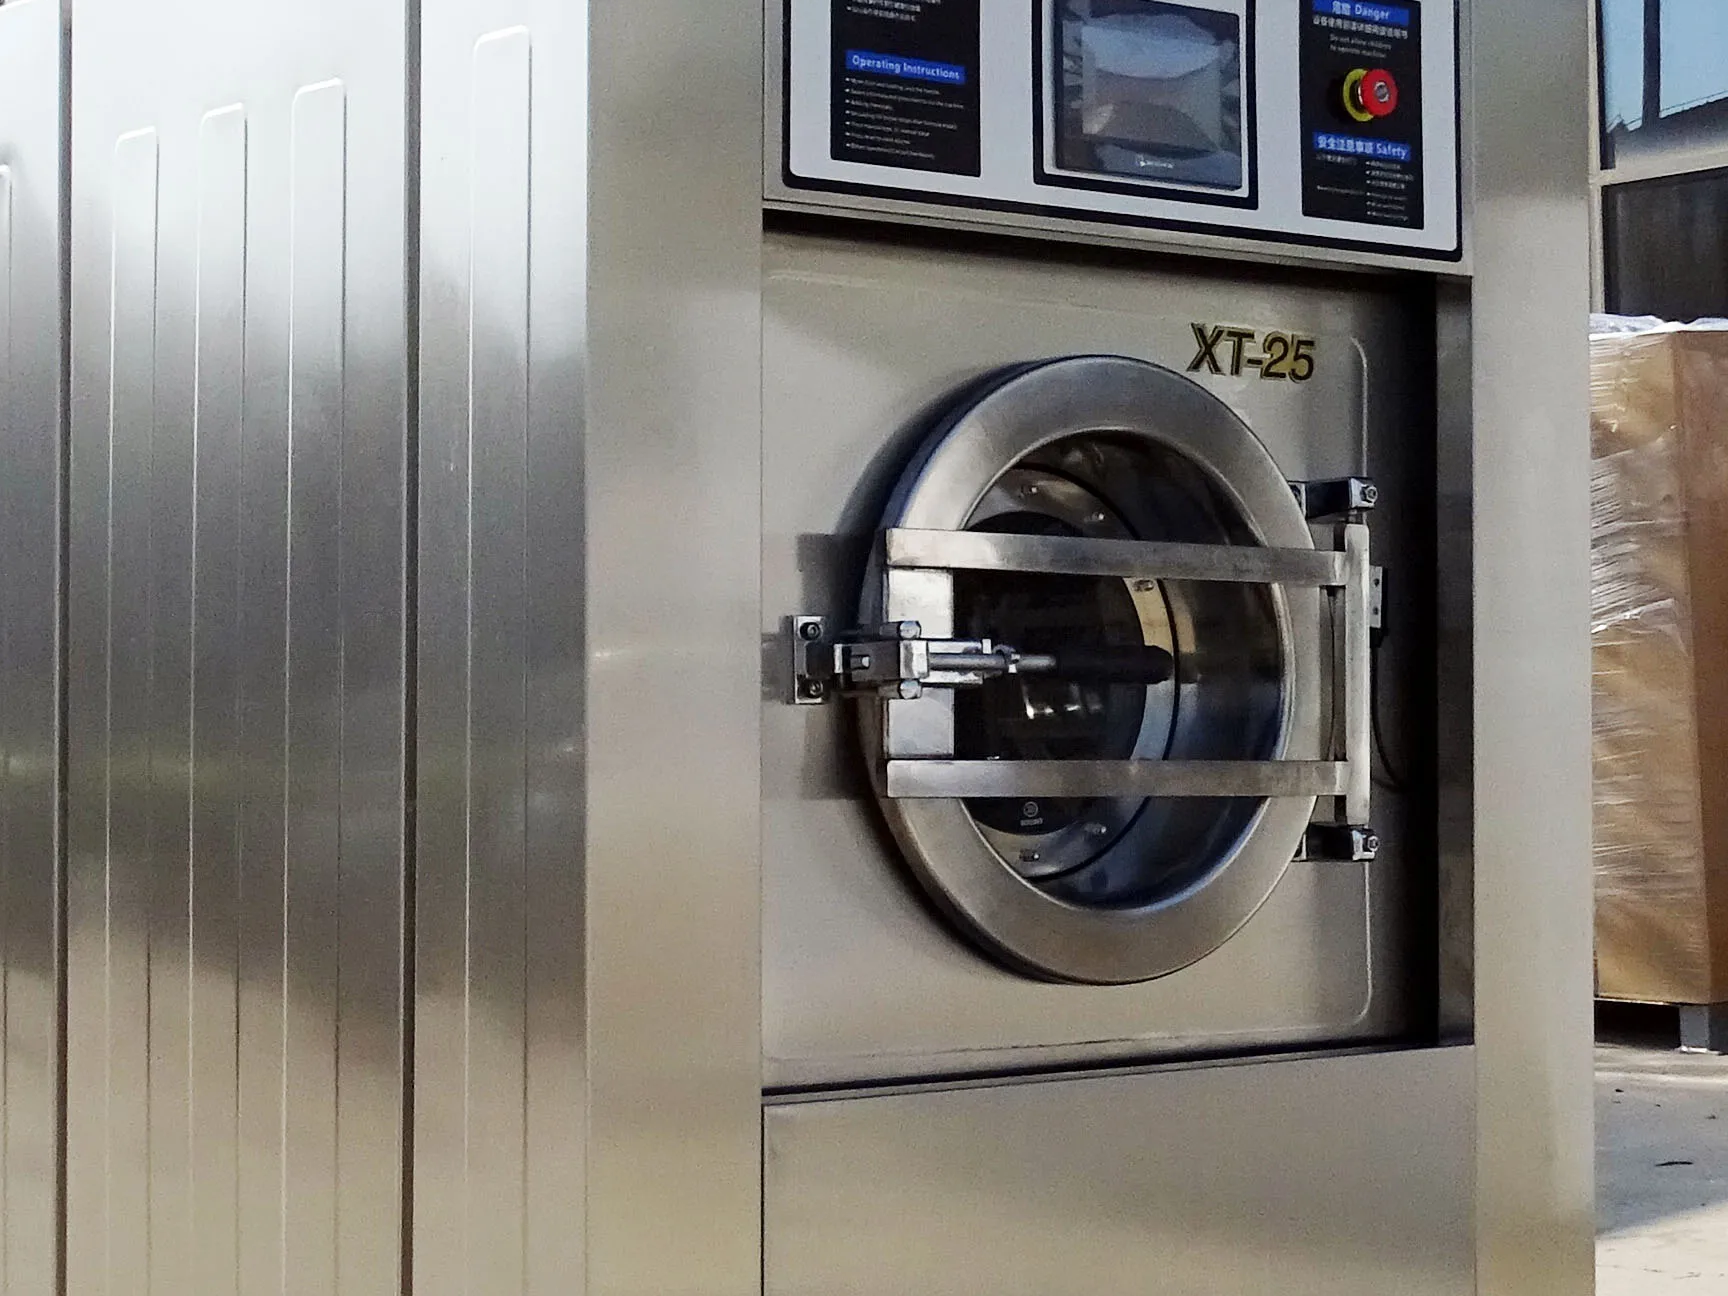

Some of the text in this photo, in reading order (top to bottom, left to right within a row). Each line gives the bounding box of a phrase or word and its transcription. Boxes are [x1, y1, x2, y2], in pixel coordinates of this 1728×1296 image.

[1355, 4, 1390, 21] Danger
[852, 55, 960, 80] Operating Instructions
[1376, 143, 1408, 160] Safety
[1186, 322, 1316, 384] XT-25
